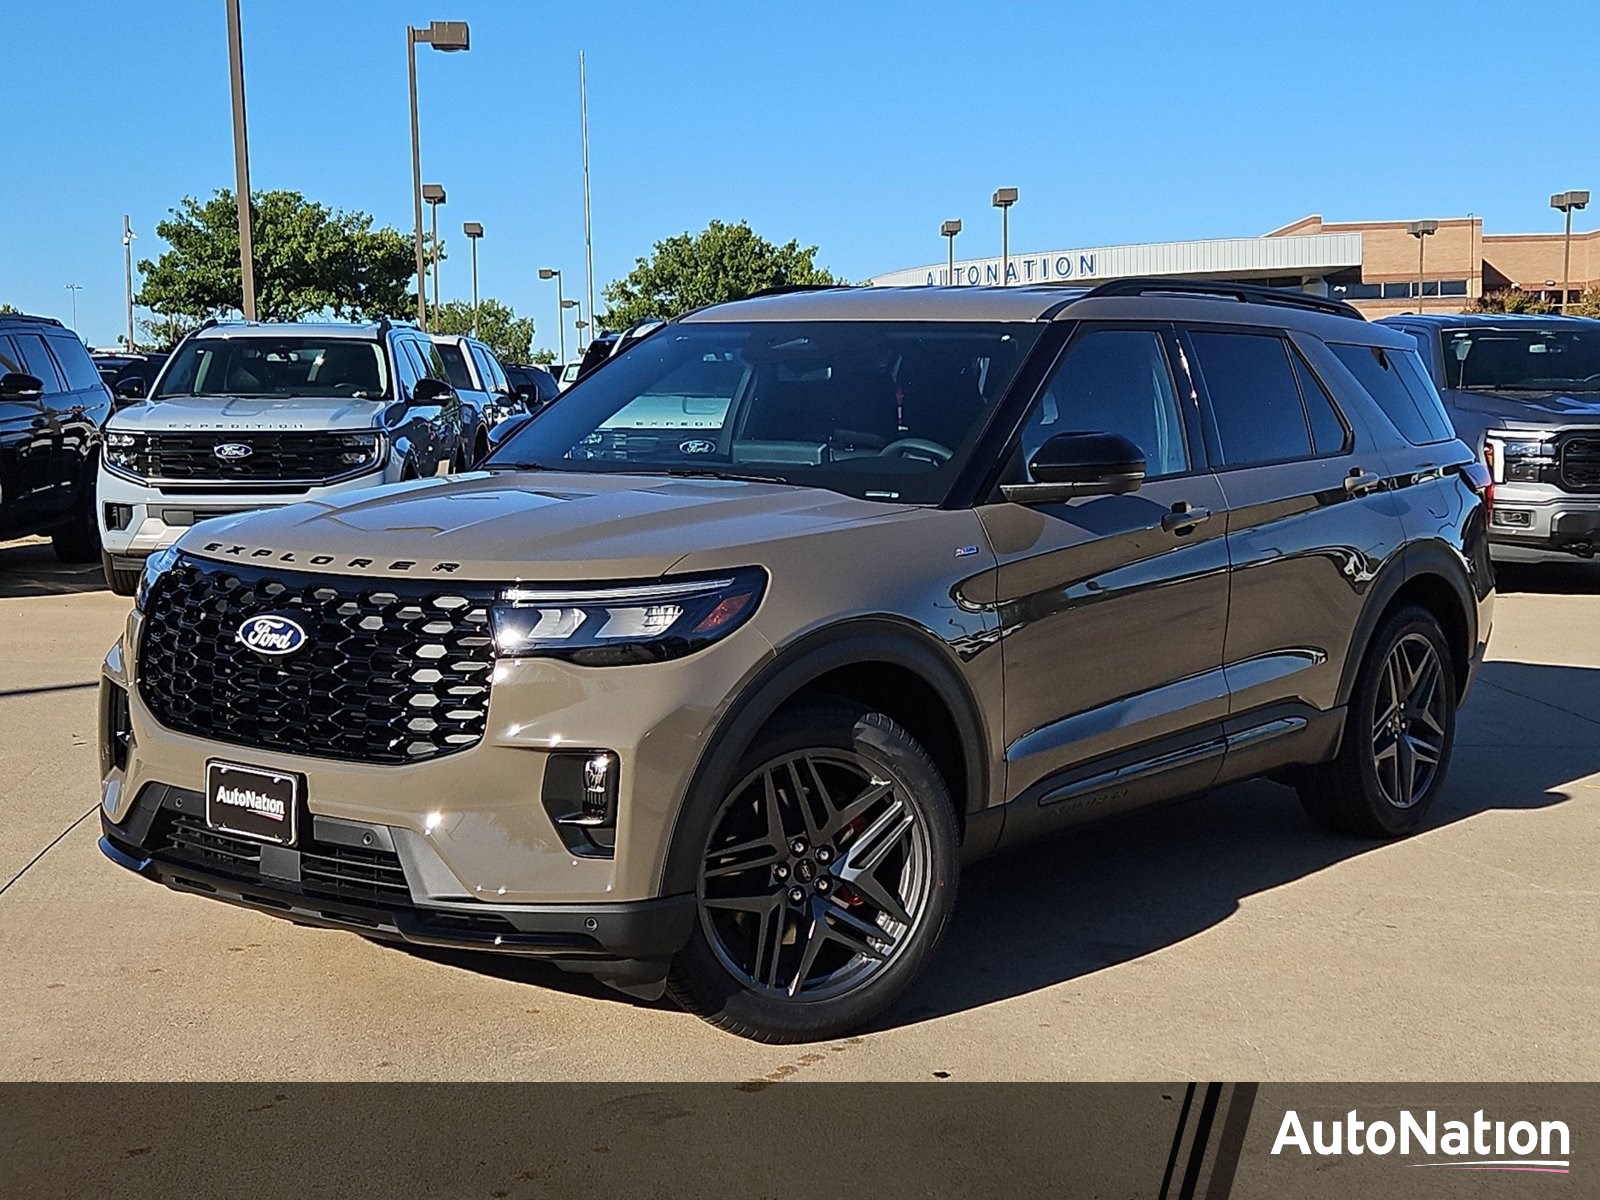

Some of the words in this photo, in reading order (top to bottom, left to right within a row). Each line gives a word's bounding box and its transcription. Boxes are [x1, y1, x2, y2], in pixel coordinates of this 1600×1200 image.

[926, 254, 1096, 287] AUTONATION
[203, 543, 461, 573] EXPLORER
[247, 619, 295, 650] Ford
[216, 785, 285, 815] AutoNation
